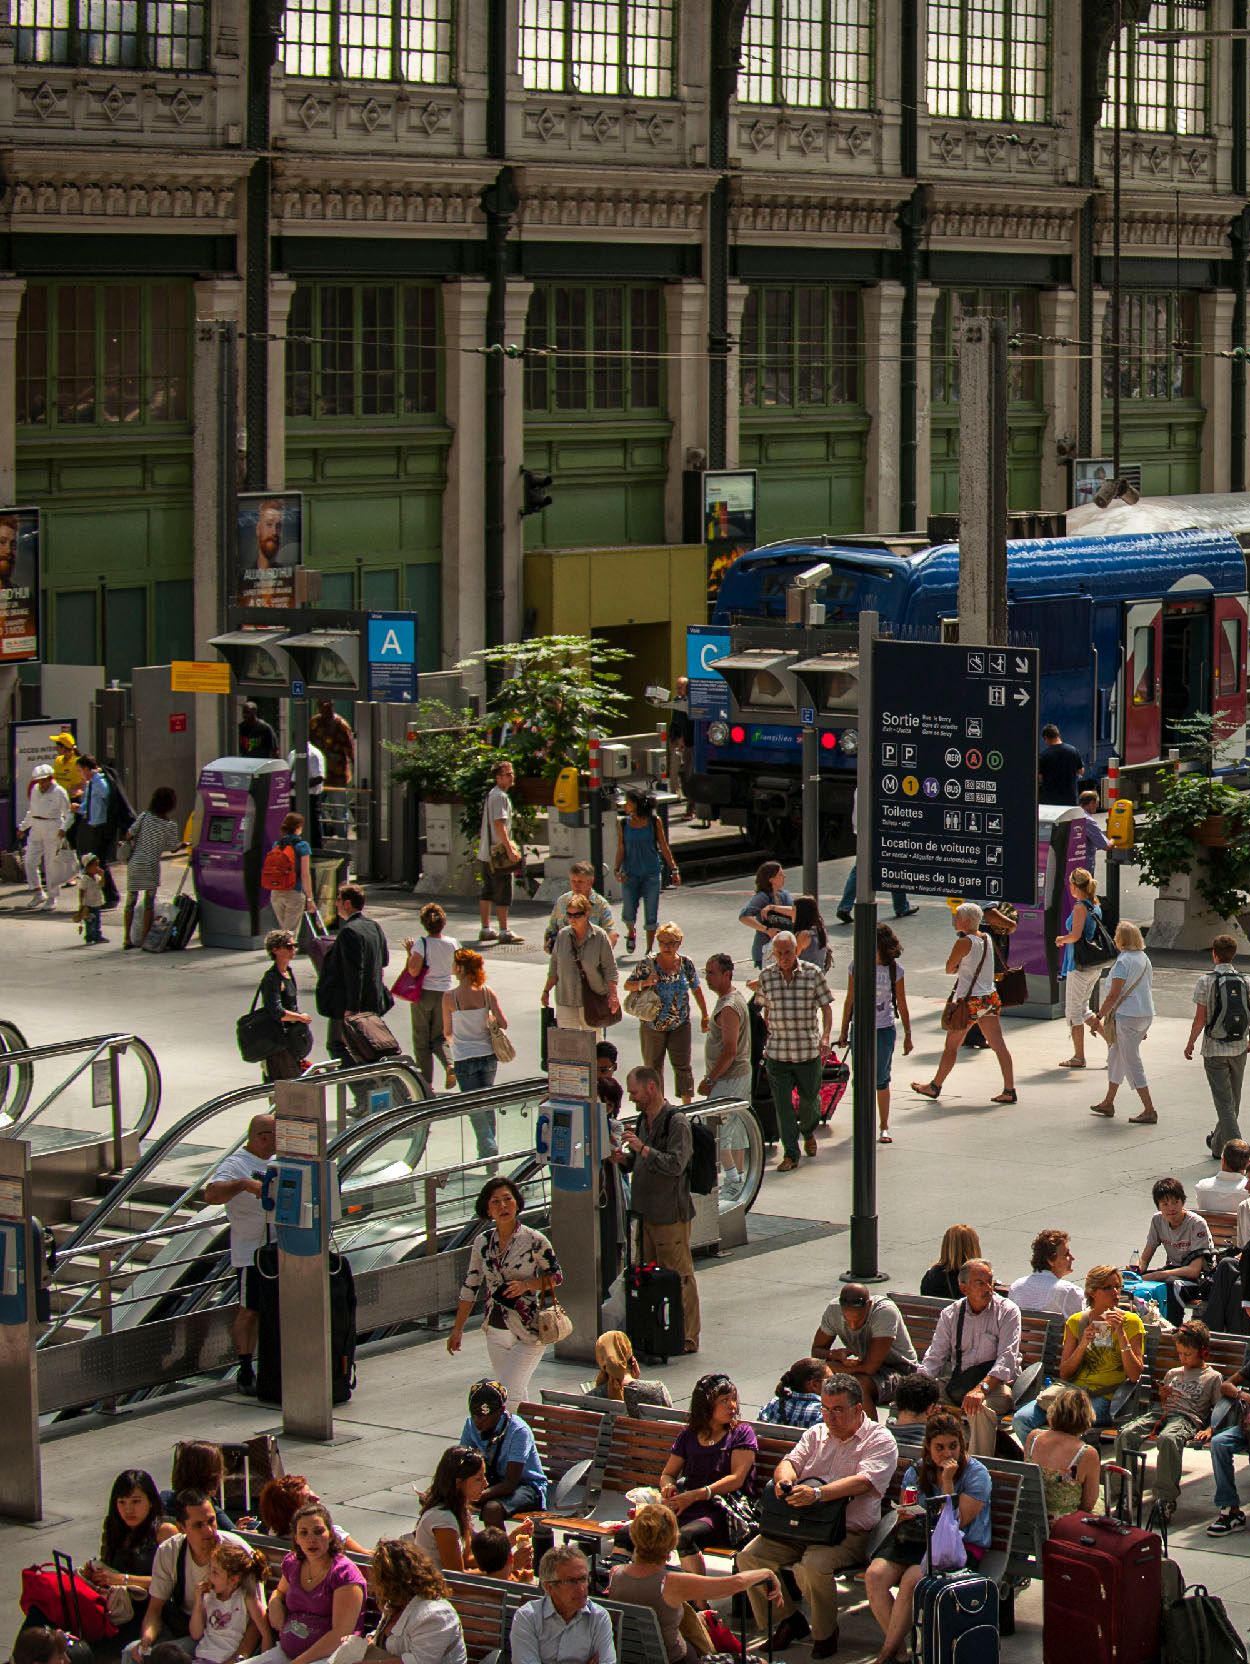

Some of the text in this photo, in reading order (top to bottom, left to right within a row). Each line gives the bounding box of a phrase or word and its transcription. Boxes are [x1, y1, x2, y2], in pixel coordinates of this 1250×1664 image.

[381, 629, 402, 655] A
[701, 644, 718, 671] C
[882, 712, 920, 727] Sortie
[886, 746, 914, 760] P P
[946, 754, 960, 762] RER
[970, 754, 977, 764] A
[991, 755, 999, 765] D
[908, 781, 912, 791] 1
[926, 782, 937, 793] 14
[947, 785, 958, 793] BUS
[882, 805, 923, 818] Toilettes
[882, 836, 981, 855] Location de voitures
[882, 867, 982, 886] Boutiques de la gare
